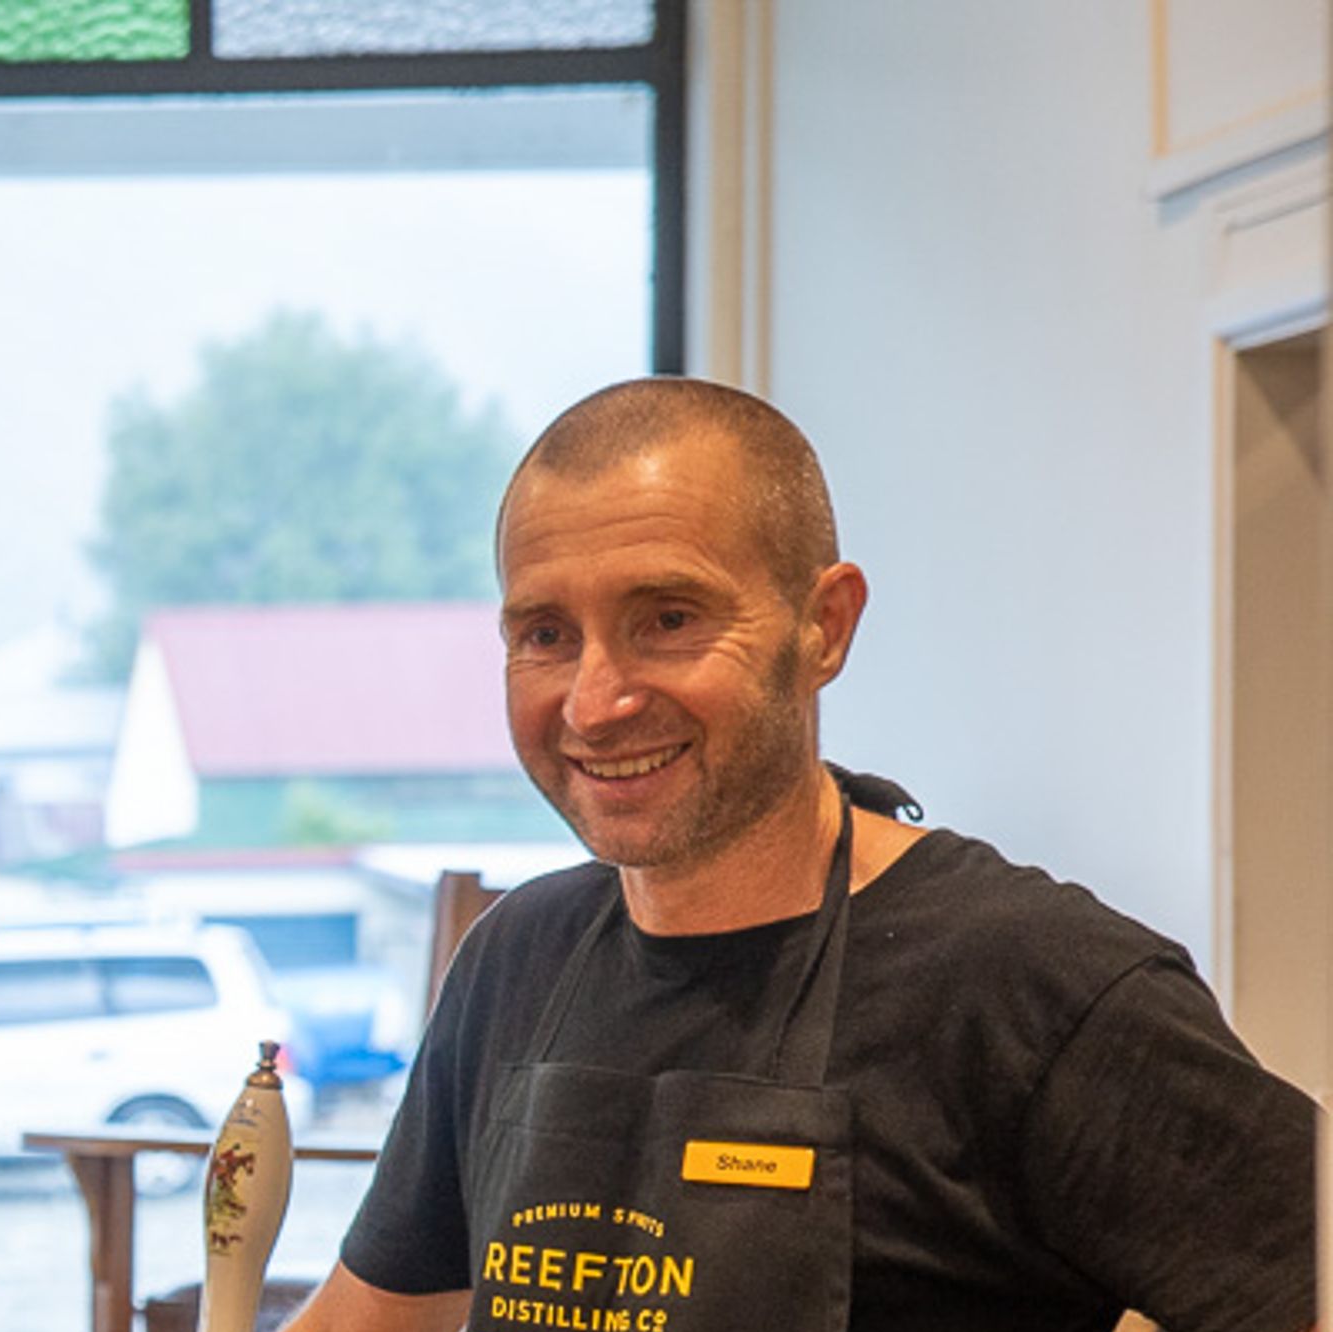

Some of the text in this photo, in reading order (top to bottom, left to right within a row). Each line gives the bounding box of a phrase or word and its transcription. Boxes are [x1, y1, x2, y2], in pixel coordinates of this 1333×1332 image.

[716, 1153, 778, 1174] Shane
[511, 1203, 602, 1228] PREMIUM
[484, 1241, 695, 1297] REEFTON
